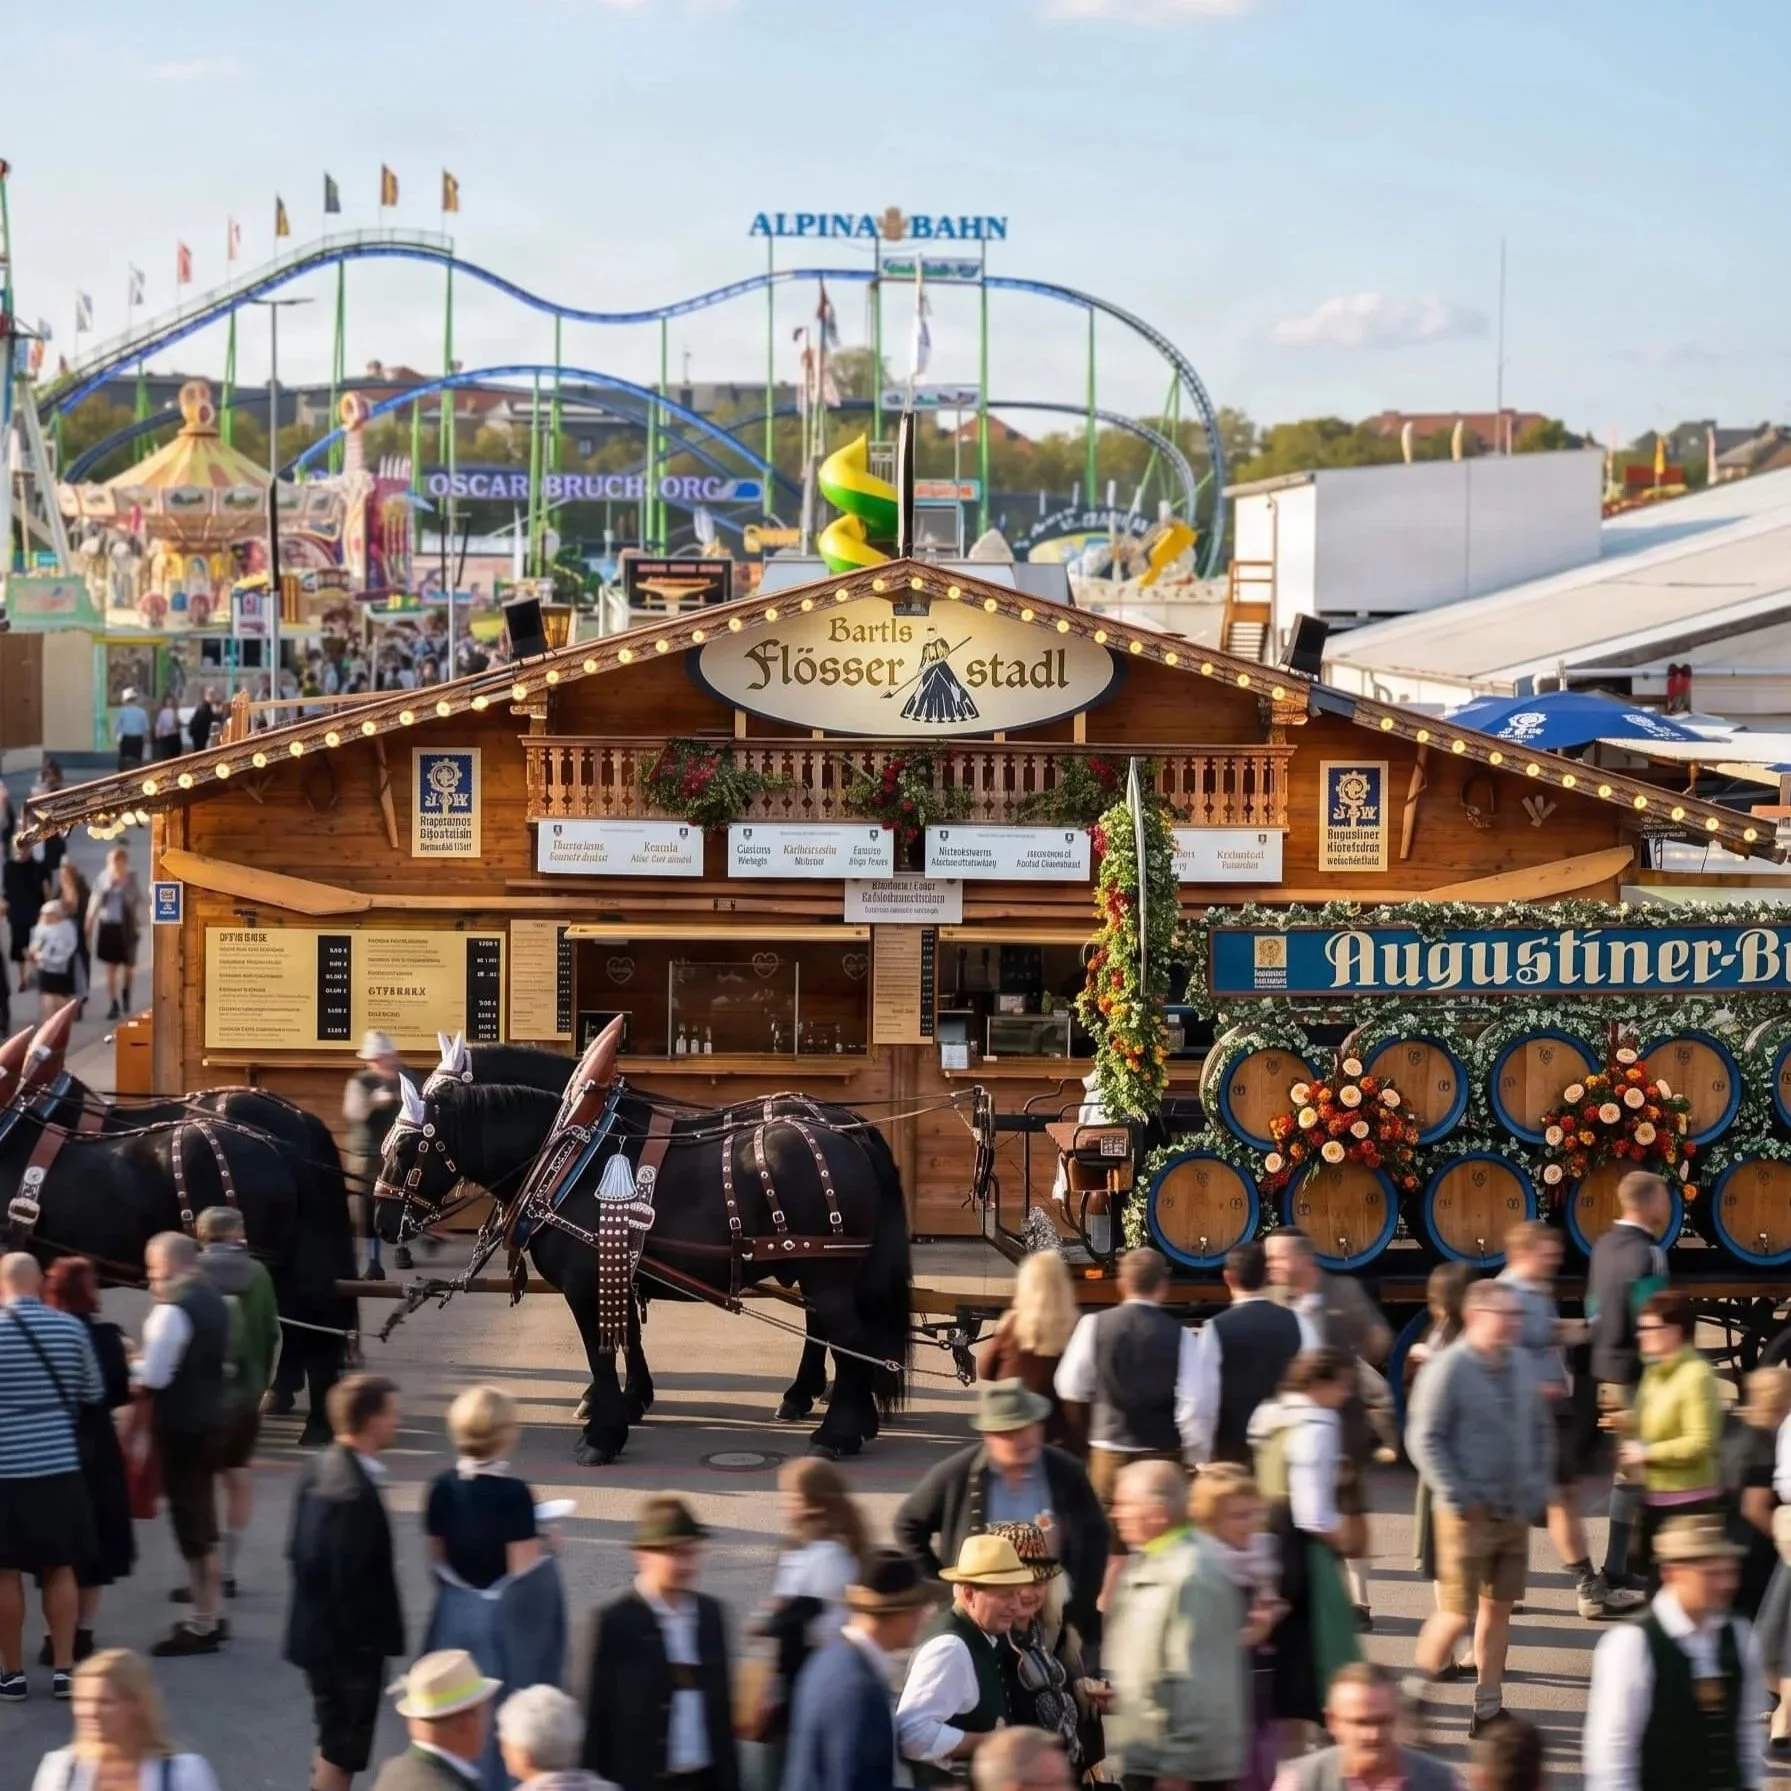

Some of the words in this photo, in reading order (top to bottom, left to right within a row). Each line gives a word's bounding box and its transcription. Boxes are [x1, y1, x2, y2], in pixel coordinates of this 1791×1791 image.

[749, 212, 877, 237] ALPINA
[911, 215, 1008, 240] BAHN
[429, 472, 528, 498] OSCAR
[545, 475, 643, 498] BRUCH
[828, 617, 913, 643] Bartls
[744, 638, 905, 690] Flösser
[965, 648, 1070, 689] stadl
[1324, 928, 1791, 990] Augustiner-B
